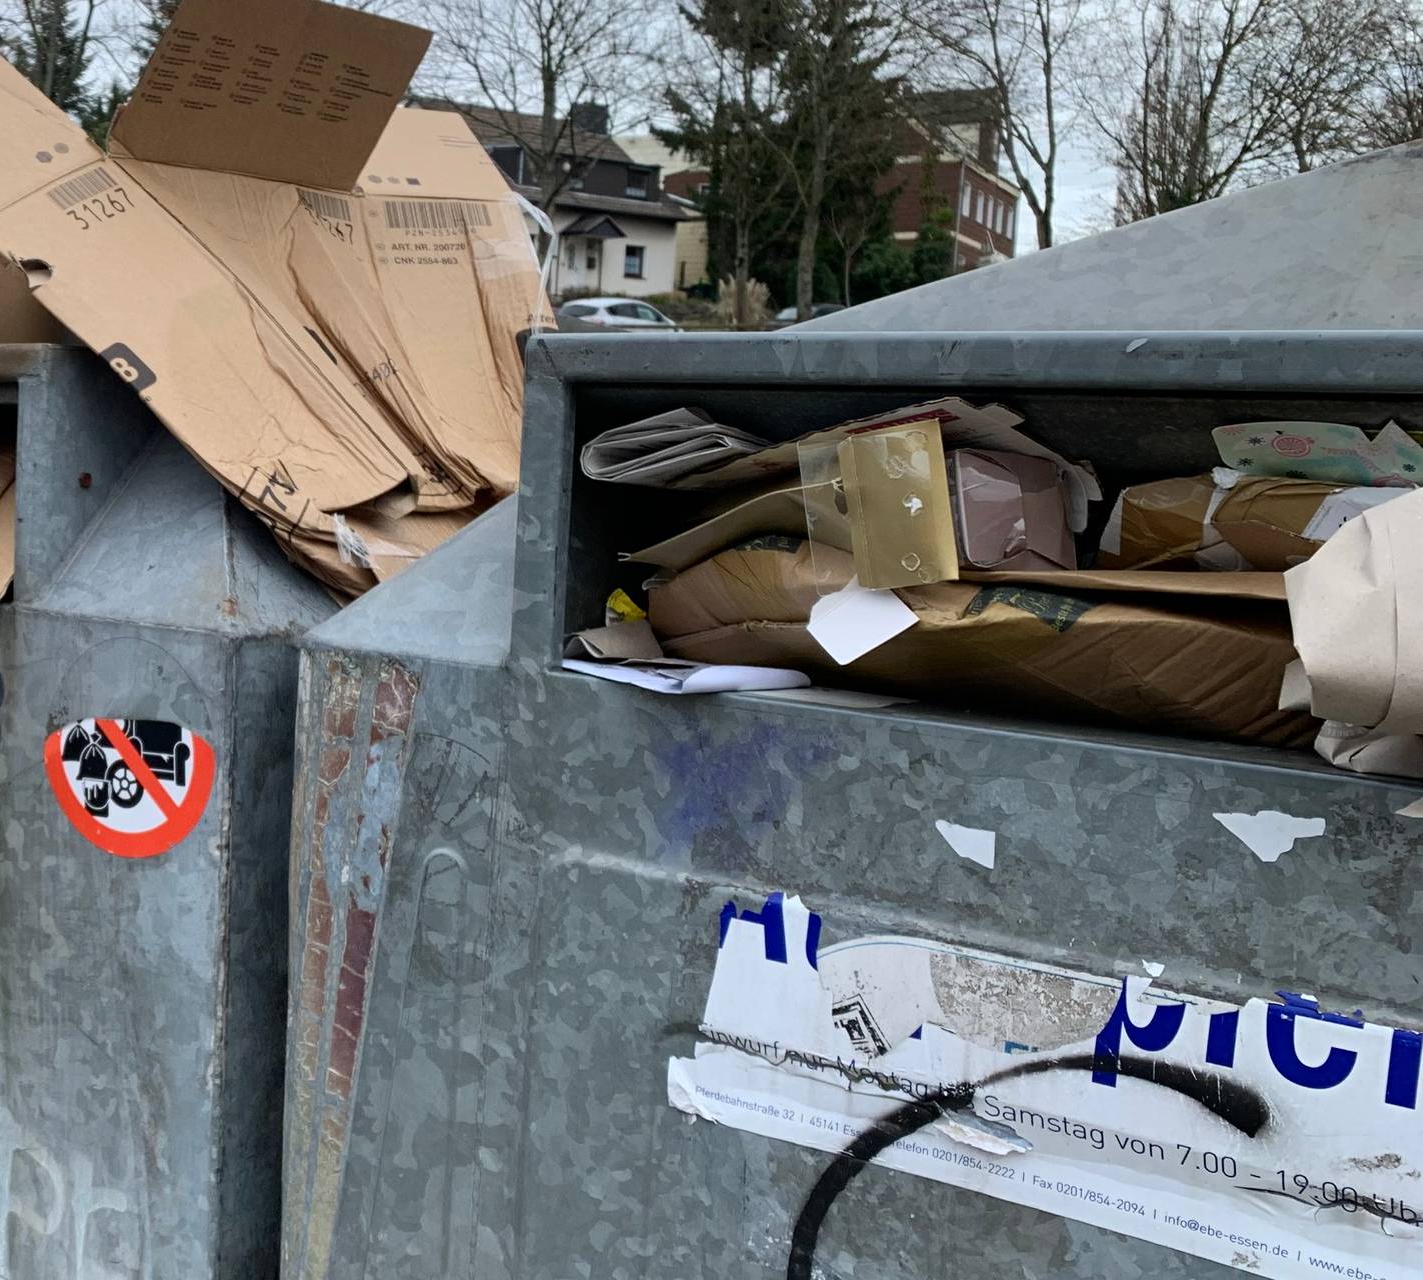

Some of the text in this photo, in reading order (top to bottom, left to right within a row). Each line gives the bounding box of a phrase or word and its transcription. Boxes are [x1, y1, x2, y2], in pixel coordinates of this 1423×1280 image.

[66, 187, 135, 230] 31267
[698, 1022, 780, 1059] inwurf
[984, 1095, 1105, 1149] Samstag
[1114, 1133, 1165, 1160] von
[1176, 1144, 1237, 1178] 7.00
[695, 1084, 780, 1118] Pferdebahnstraße
[782, 1108, 795, 1121] 32
[809, 1115, 840, 1131] 45141
[931, 1147, 1015, 1180] 0201/854-2222
[1033, 1175, 1053, 1191] Fax
[1056, 1181, 1146, 1217] 0201/854-2094
[1164, 1211, 1289, 1258] info@ebe-essen.de
[1309, 1257, 1387, 1280] www.ebe-
